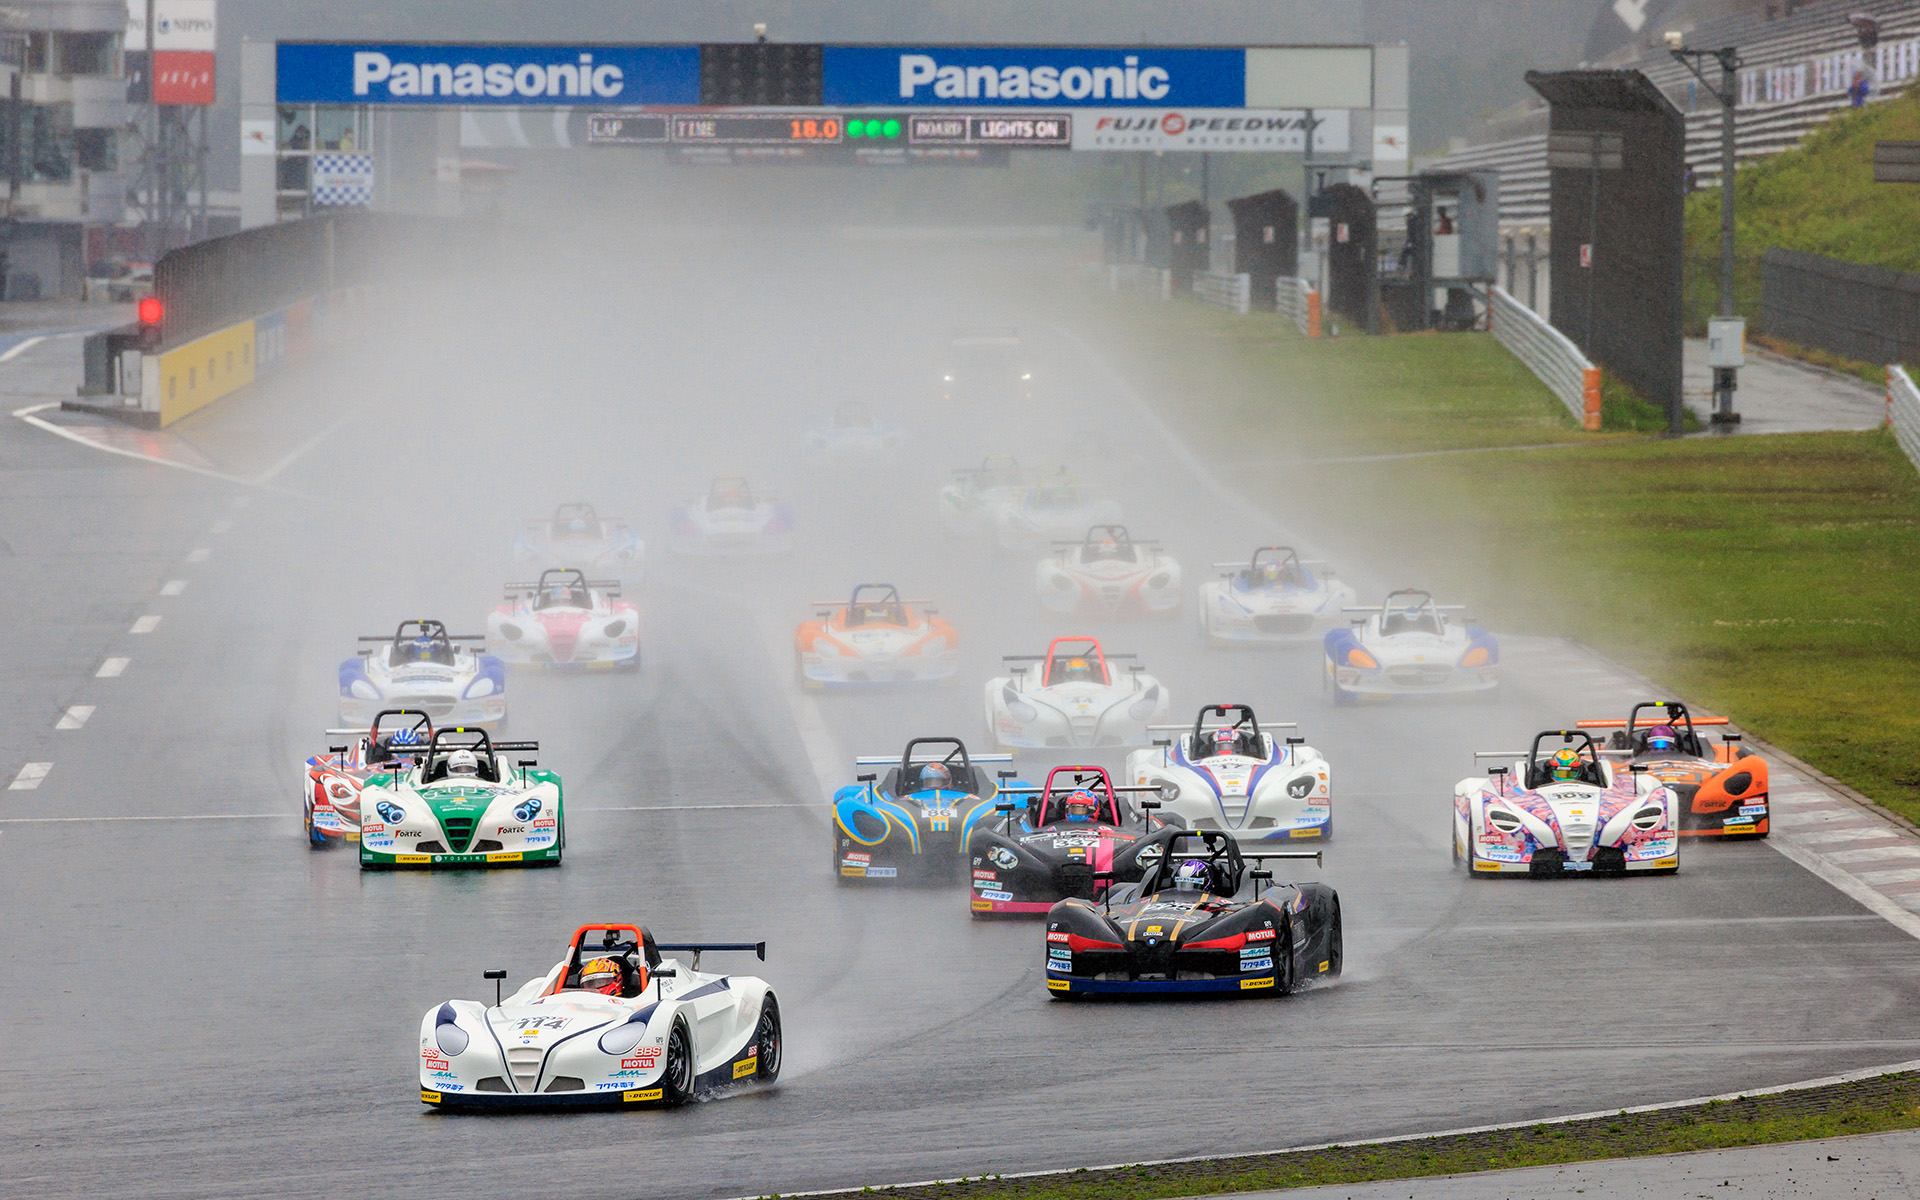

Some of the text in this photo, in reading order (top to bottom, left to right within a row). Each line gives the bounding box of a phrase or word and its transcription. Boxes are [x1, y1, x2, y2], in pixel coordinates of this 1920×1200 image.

[353, 52, 623, 97] Panasonic
[899, 53, 1170, 100] Panasonic
[591, 121, 623, 137] LAP
[790, 120, 837, 138] 18.0
[980, 121, 1059, 137] LIGHTS ON
[1096, 118, 1158, 131] FUJI
[534, 819, 555, 827] MOTUL
[395, 830, 422, 838] FORTEC
[497, 827, 525, 835] FORTEC
[847, 853, 870, 861] MOTUL
[974, 871, 995, 879] MOTUL
[1048, 933, 1068, 941] MOTUL
[1248, 930, 1274, 940] MOTUL
[1249, 979, 1273, 987] DUNLOP
[517, 1018, 564, 1030] 114
[421, 1047, 440, 1058] BBS
[635, 1046, 662, 1057] BBS
[748, 1045, 758, 1057] BBS
[427, 1060, 447, 1070] MOTUL
[622, 1059, 653, 1068] MOTUL
[738, 1061, 755, 1073] DUNLOP
[632, 1091, 661, 1099] DUNLOP
